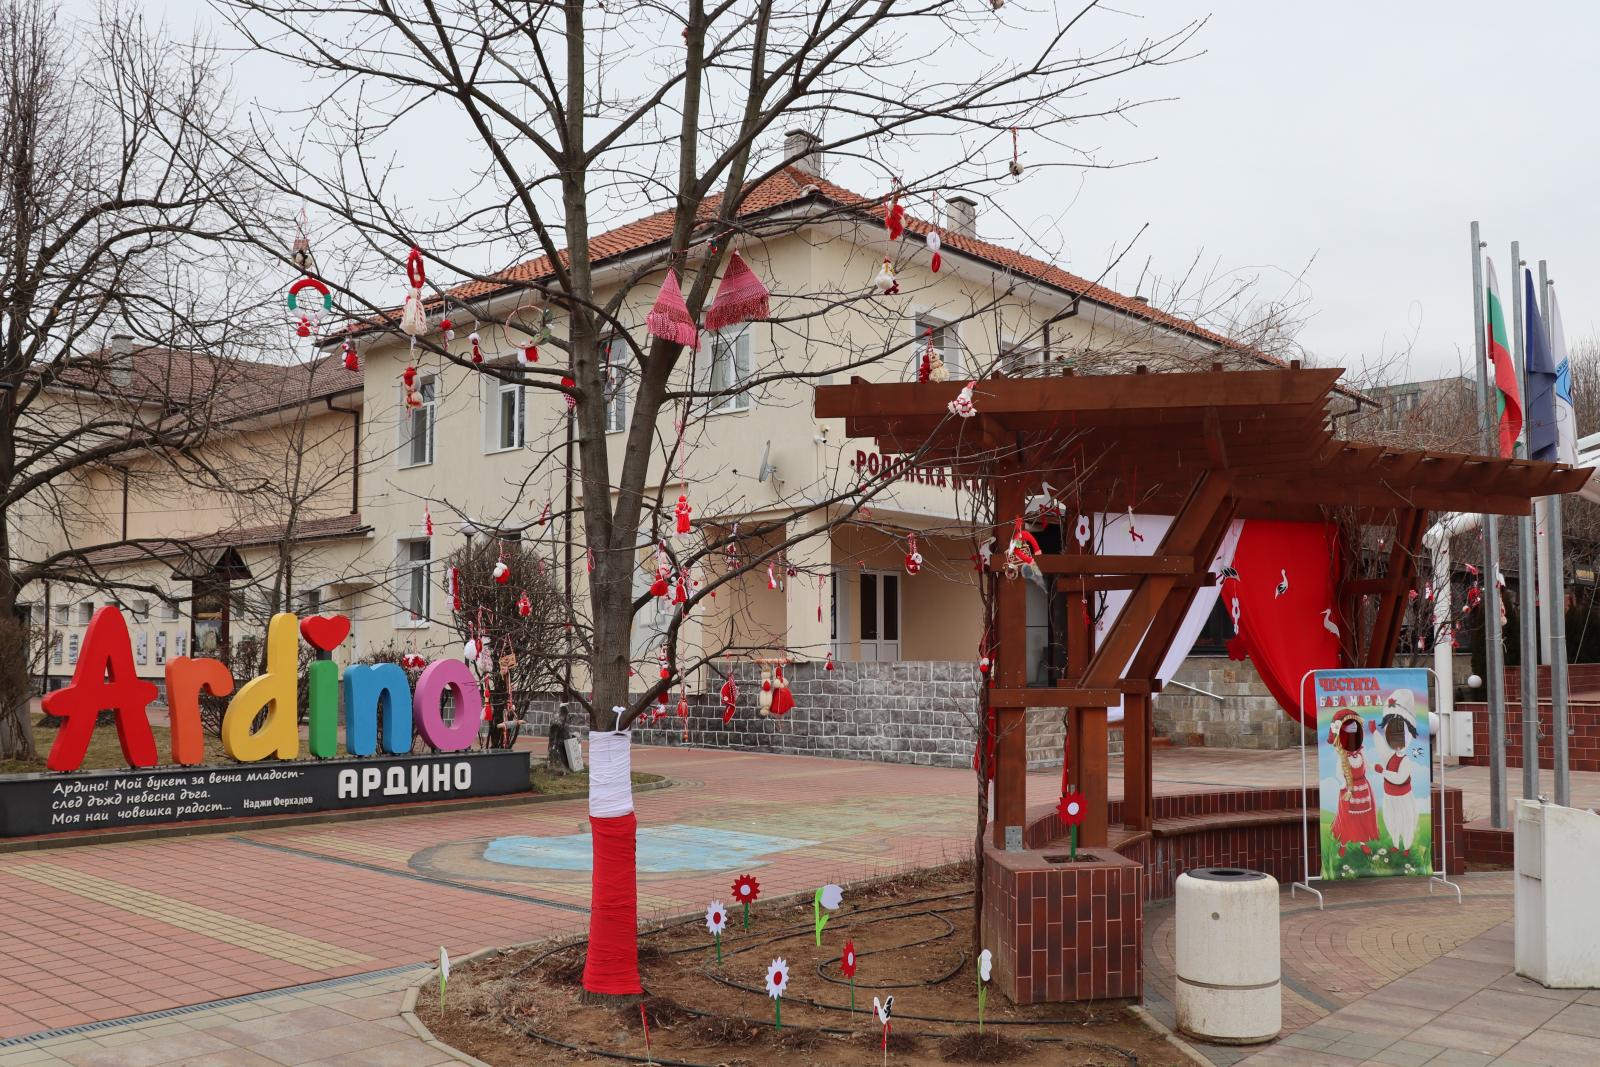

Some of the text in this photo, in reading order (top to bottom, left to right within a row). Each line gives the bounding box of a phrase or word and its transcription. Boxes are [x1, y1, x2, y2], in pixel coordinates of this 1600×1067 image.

[41, 606, 482, 771] Ardino
[1319, 677, 1380, 691] ЧЕСТИТА
[1320, 695, 1383, 707] БАБА МАРТА
[52, 769, 305, 797] Ардино! Мой букет за вечна младост-
[338, 762, 472, 799] АРДИНО
[52, 789, 211, 809] след дъжд небесна дъга.
[243, 796, 313, 809] Наджи Ферхадов
[52, 813, 80, 825] Моя
[117, 806, 172, 819] човешка
